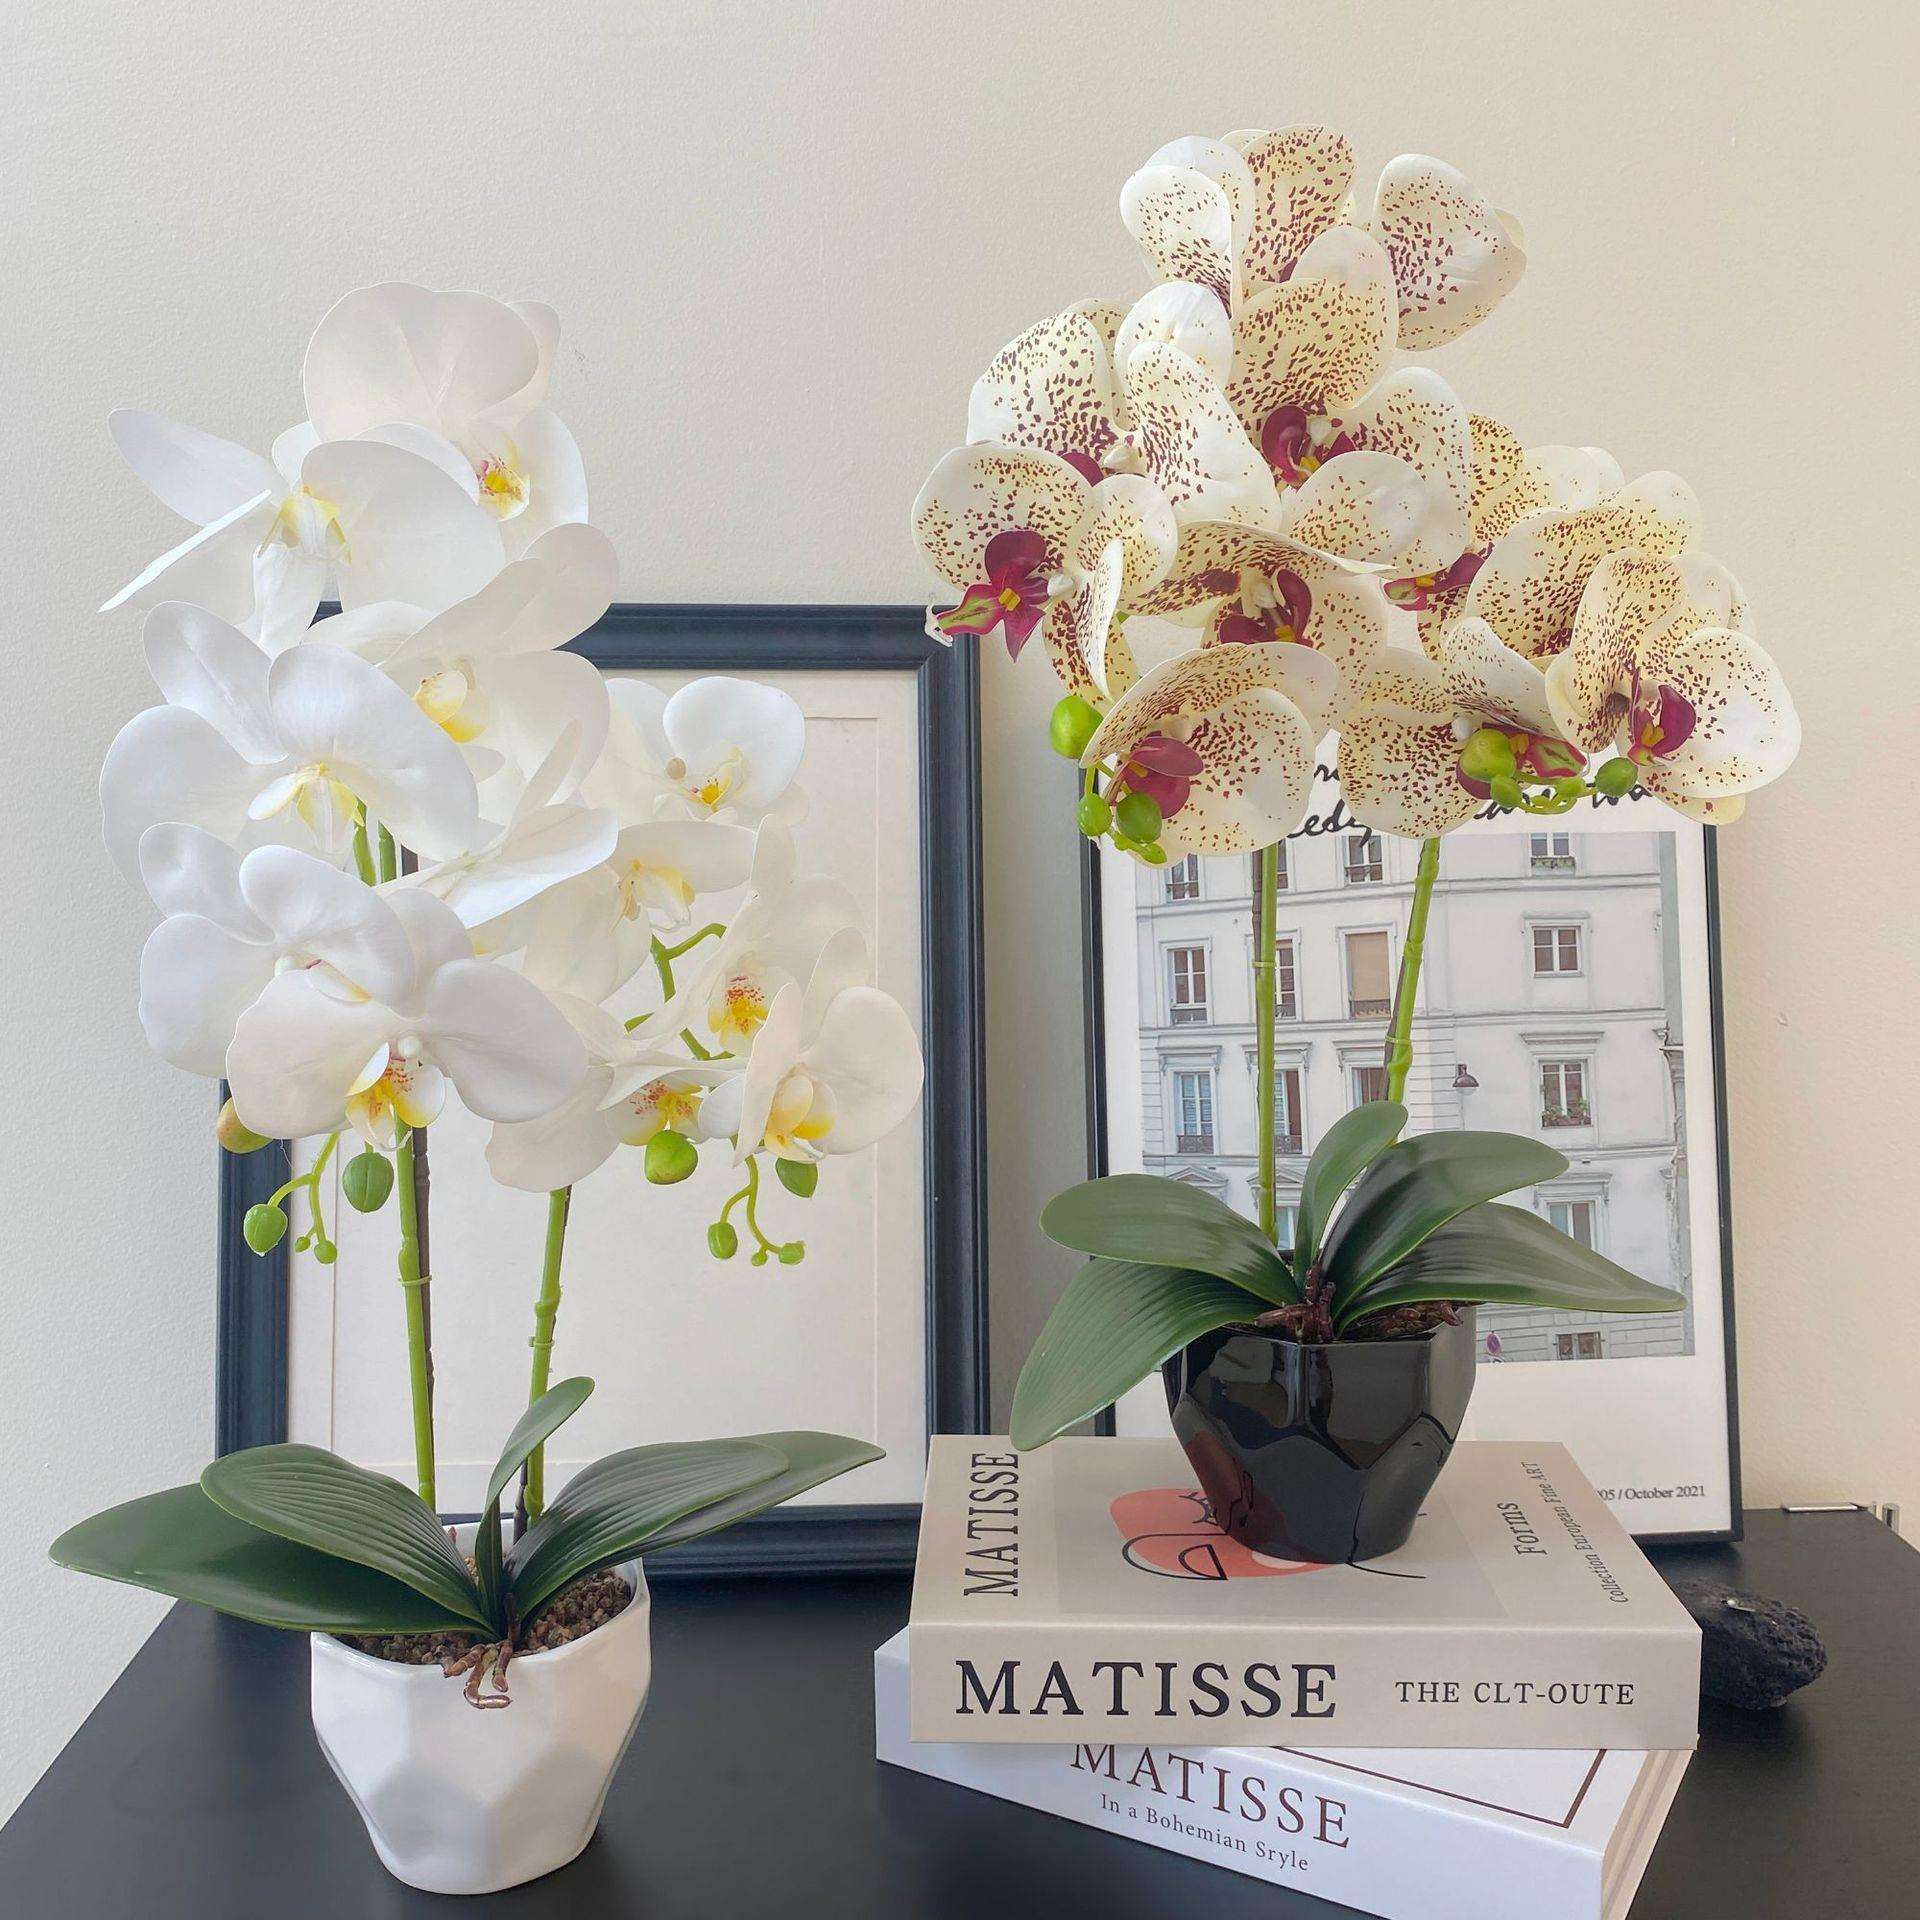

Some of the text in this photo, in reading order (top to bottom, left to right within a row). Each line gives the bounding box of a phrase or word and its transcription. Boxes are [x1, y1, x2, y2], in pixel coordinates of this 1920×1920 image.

[963, 1453, 1019, 1597] MATISSE
[1497, 1501, 1548, 1555] Forms
[1520, 1461, 1629, 1603] Collection European Fine ART
[1625, 1486, 1674, 1501] October
[1676, 1485, 1705, 1498] 2021
[955, 1660, 1635, 1718] MATISSE THE CLT-OUTE
[1070, 1744, 1350, 1848] MATISSE
[1101, 1793, 1310, 1872] In a Bohemian Sryle
